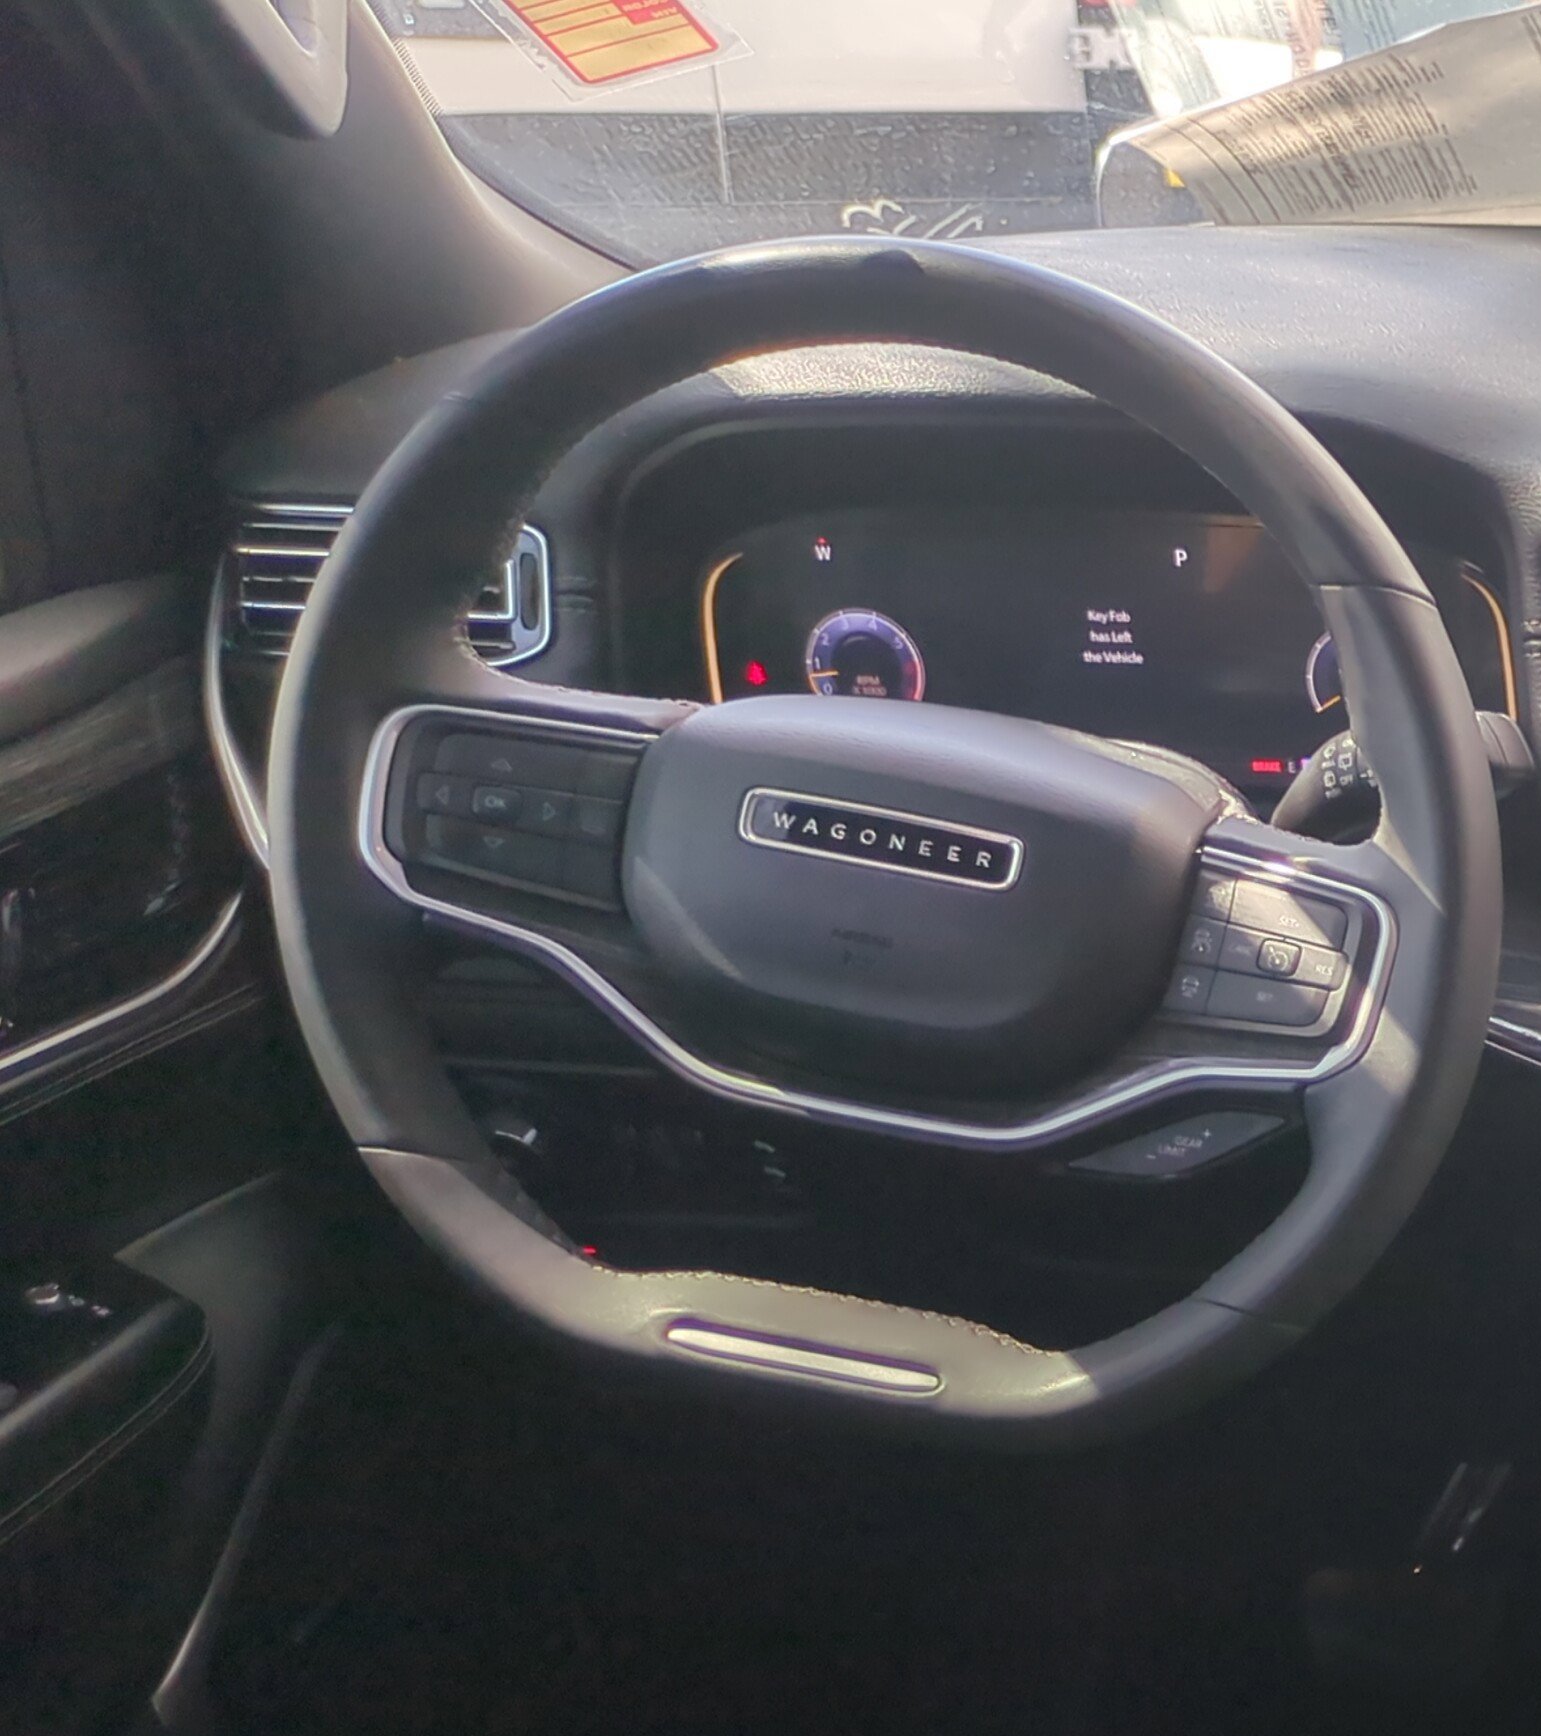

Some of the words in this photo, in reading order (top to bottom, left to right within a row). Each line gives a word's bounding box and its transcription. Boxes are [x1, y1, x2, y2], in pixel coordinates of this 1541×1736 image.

[815, 545, 831, 561] W
[1175, 548, 1188, 567] P
[1087, 609, 1107, 624] Key
[1108, 609, 1131, 622] Fob
[820, 632, 829, 646] 2
[1089, 630, 1110, 642] has
[1111, 630, 1133, 643] Left
[1083, 651, 1102, 663] the
[1102, 651, 1143, 664] Vehicle
[484, 795, 506, 809] OK
[773, 811, 993, 869] WAGONEER
[1314, 964, 1333, 976] RES
